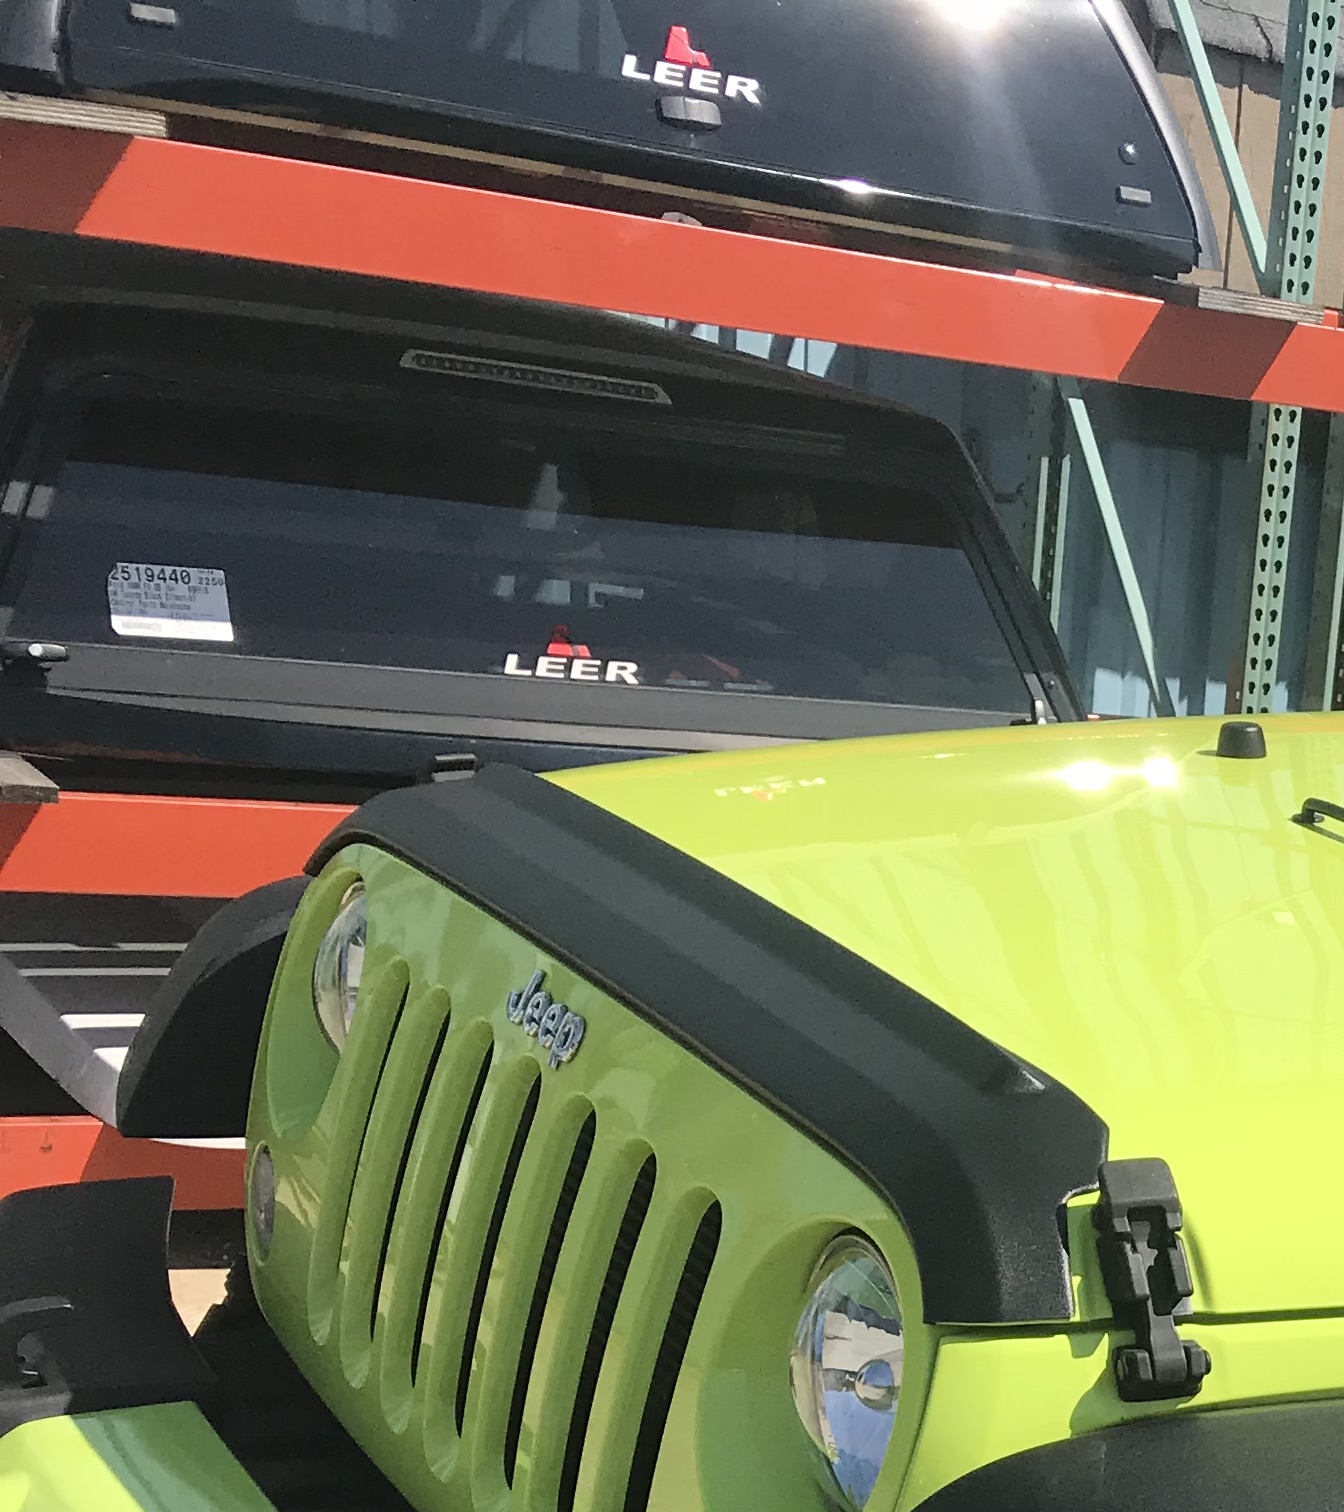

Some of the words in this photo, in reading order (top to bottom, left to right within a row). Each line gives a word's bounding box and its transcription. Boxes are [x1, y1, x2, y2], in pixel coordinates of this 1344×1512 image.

[621, 53, 762, 105] LEER
[110, 565, 191, 585] 2519440
[504, 652, 639, 684] LEER
[506, 969, 586, 1069] Jeep
